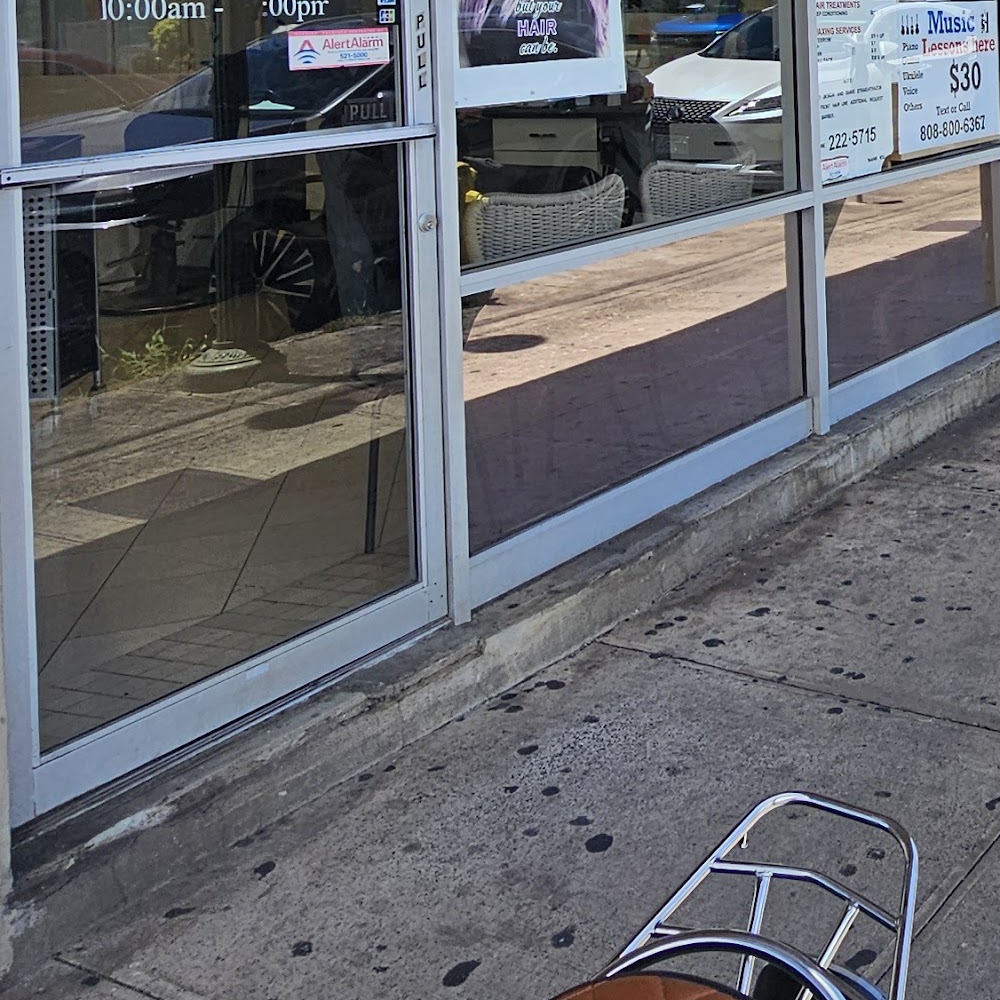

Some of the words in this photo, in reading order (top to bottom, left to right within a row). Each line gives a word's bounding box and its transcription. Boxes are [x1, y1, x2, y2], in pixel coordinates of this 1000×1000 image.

[515, 0, 535, 14] but
[533, 1, 563, 20] your
[815, 1, 825, 10] AIR
[826, 1, 861, 9] TREATMENTS
[517, 18, 558, 38] HAIR
[817, 27, 835, 35] AXING
[835, 26, 862, 35] SERVICES
[927, 10, 976, 35] Music
[322, 36, 384, 51] AlertAlarm
[416, 13, 428, 90] PULL
[519, 42, 541, 56] can
[921, 38, 969, 57] Lessons
[972, 36, 996, 53] here
[949, 59, 981, 99] $30
[902, 86, 918, 96] Voice
[349, 102, 388, 121] PULL
[903, 102, 923, 112] Others
[936, 105, 950, 116] Text
[951, 105, 958, 114] or
[958, 101, 971, 113] Call
[920, 115, 986, 141] 808-800-6367
